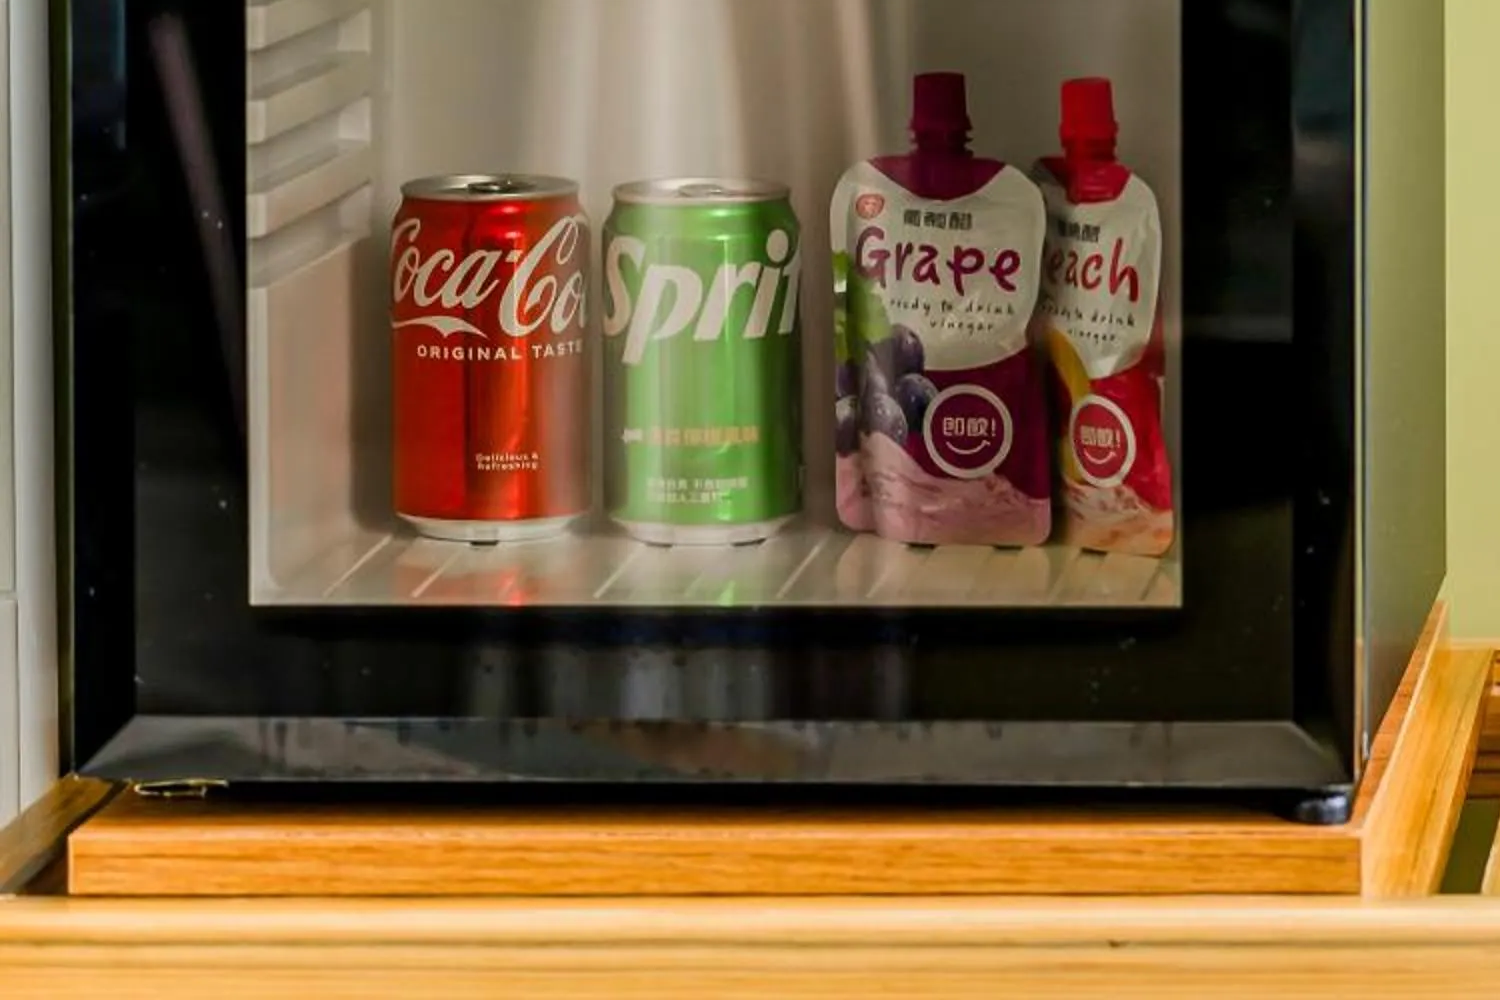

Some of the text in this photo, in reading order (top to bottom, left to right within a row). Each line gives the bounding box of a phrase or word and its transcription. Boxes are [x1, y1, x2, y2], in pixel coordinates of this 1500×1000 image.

[855, 226, 1021, 297] Grape
[1046, 237, 1139, 302] each
[965, 301, 1015, 316] drink
[930, 318, 994, 335] vinegar
[417, 345, 523, 360] ORIGINAL
